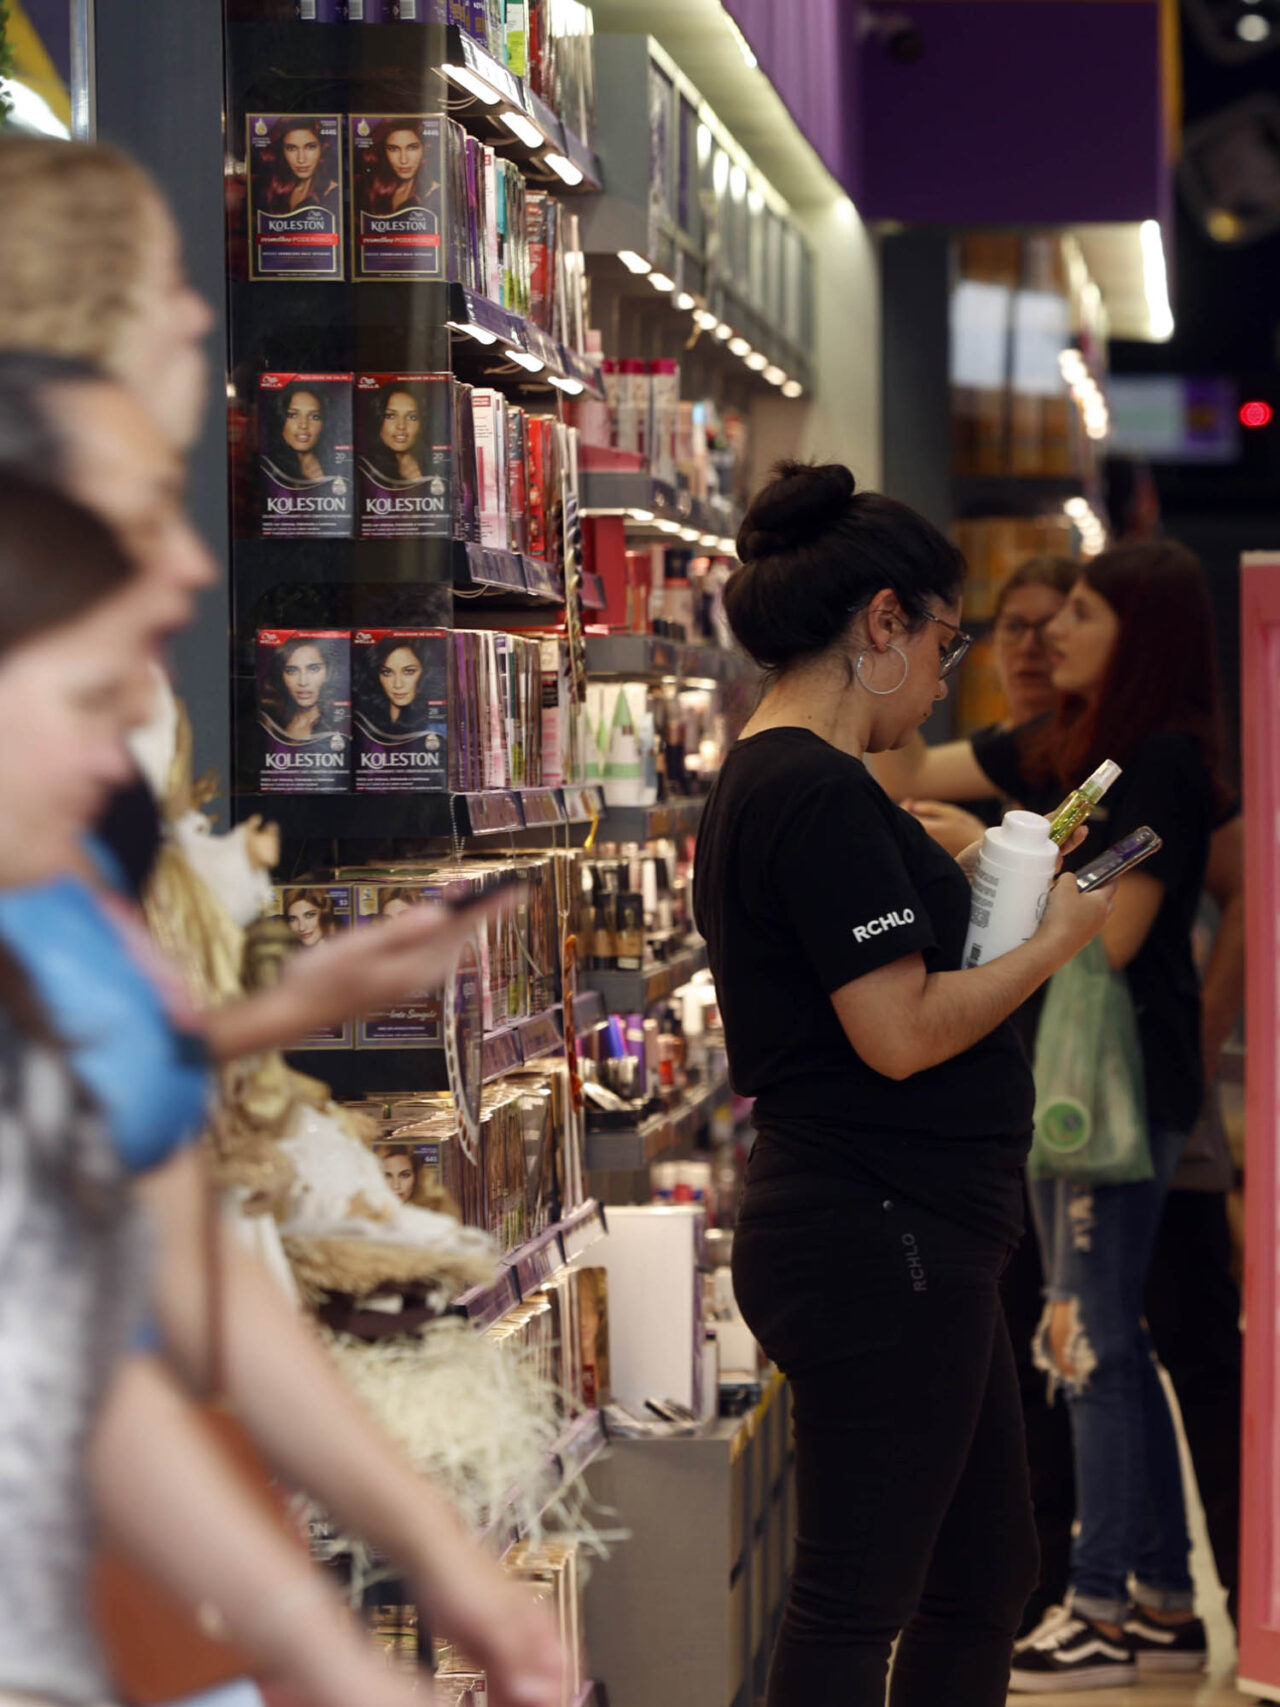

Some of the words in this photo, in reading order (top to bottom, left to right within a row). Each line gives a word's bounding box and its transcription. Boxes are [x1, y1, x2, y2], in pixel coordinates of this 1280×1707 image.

[268, 220, 325, 232] KOLESTON
[371, 221, 427, 233] KOLESTON
[267, 497, 346, 514] KOLESTON
[366, 498, 444, 515] KOLESTON
[265, 753, 344, 769] KOLESTON
[361, 752, 439, 769] KOLESTON
[852, 908, 915, 942] RCHLO
[901, 1233, 927, 1291] RCHLO
